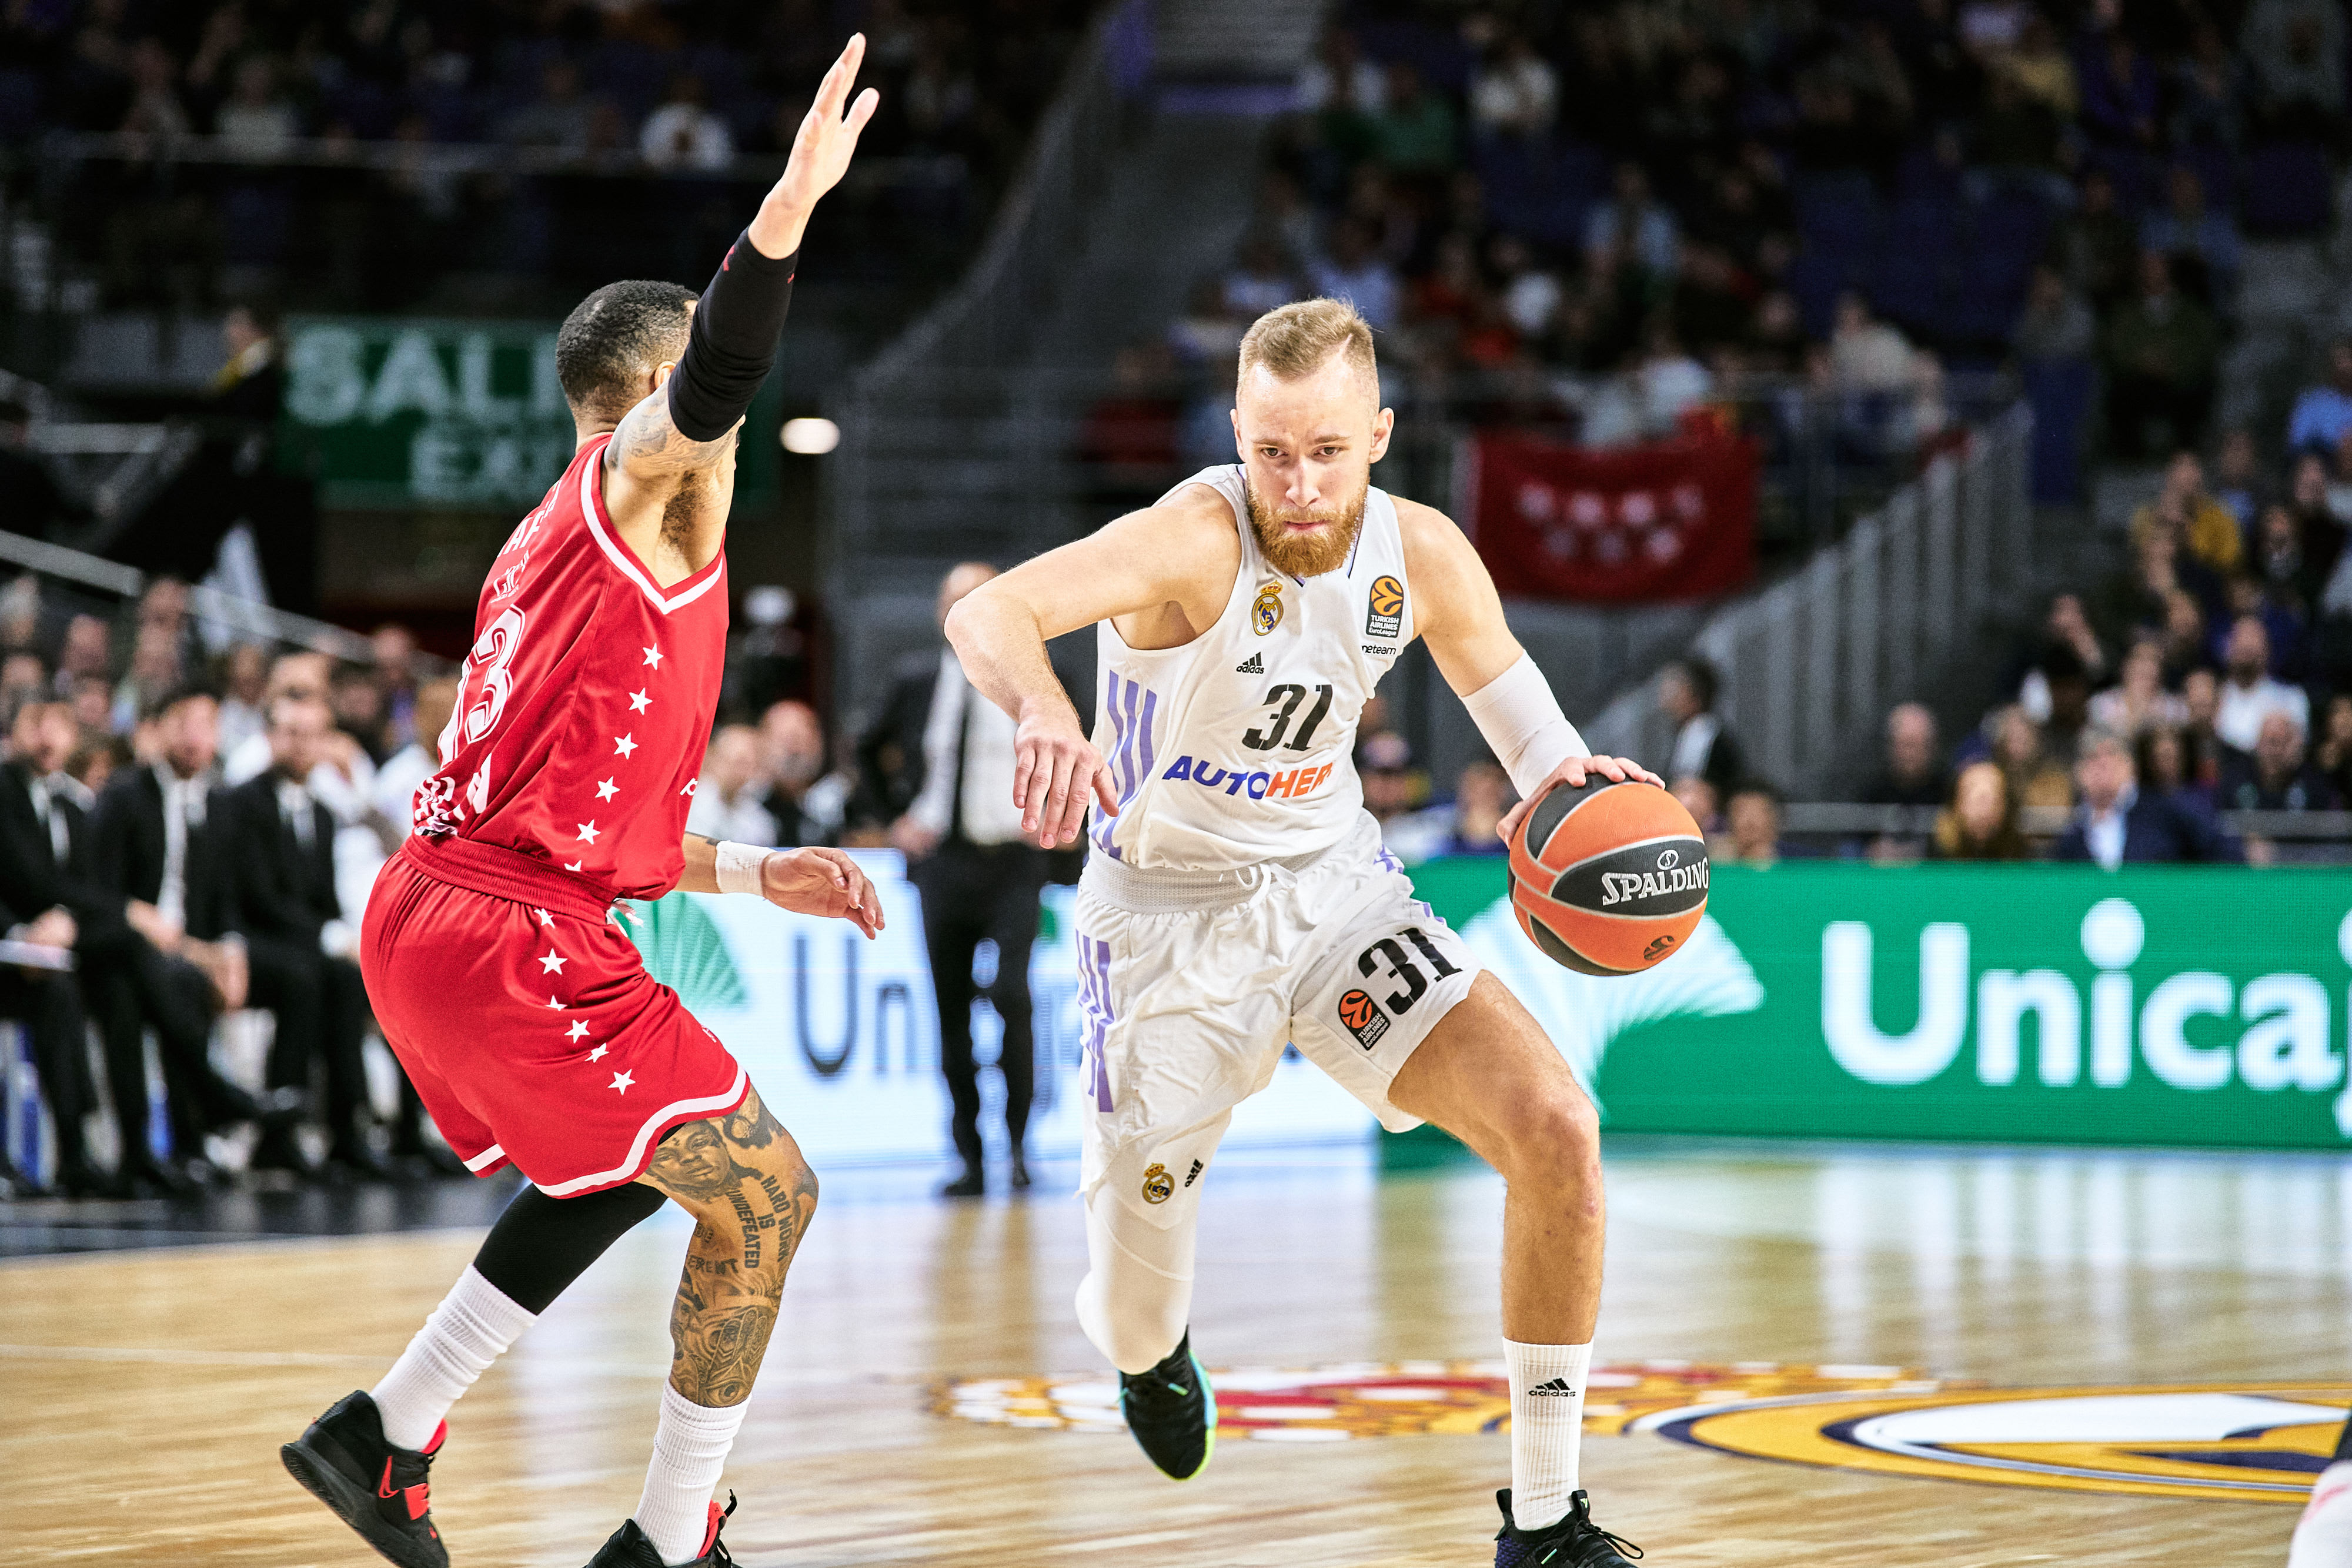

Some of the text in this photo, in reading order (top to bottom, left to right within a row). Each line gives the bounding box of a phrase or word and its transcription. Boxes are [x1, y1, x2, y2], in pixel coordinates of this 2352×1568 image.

[1369, 621, 1398, 630] AIRLINES
[1371, 614, 1399, 624] TURKISH
[1236, 664, 1265, 674] adidas
[1242, 684, 1334, 751] 31
[1601, 856, 1709, 906] SPALDING
[1358, 927, 1464, 1015] 31
[1358, 1012, 1382, 1038] TURKISH
[1363, 1017, 1385, 1044] AIRLINES
[1821, 897, 2352, 1139] Unica
[725, 1189, 761, 1268] UNDEFEATED
[757, 1213, 776, 1229] IS
[761, 1175, 793, 1262] HARD WORK
[1528, 1388, 1576, 1397] adidas
